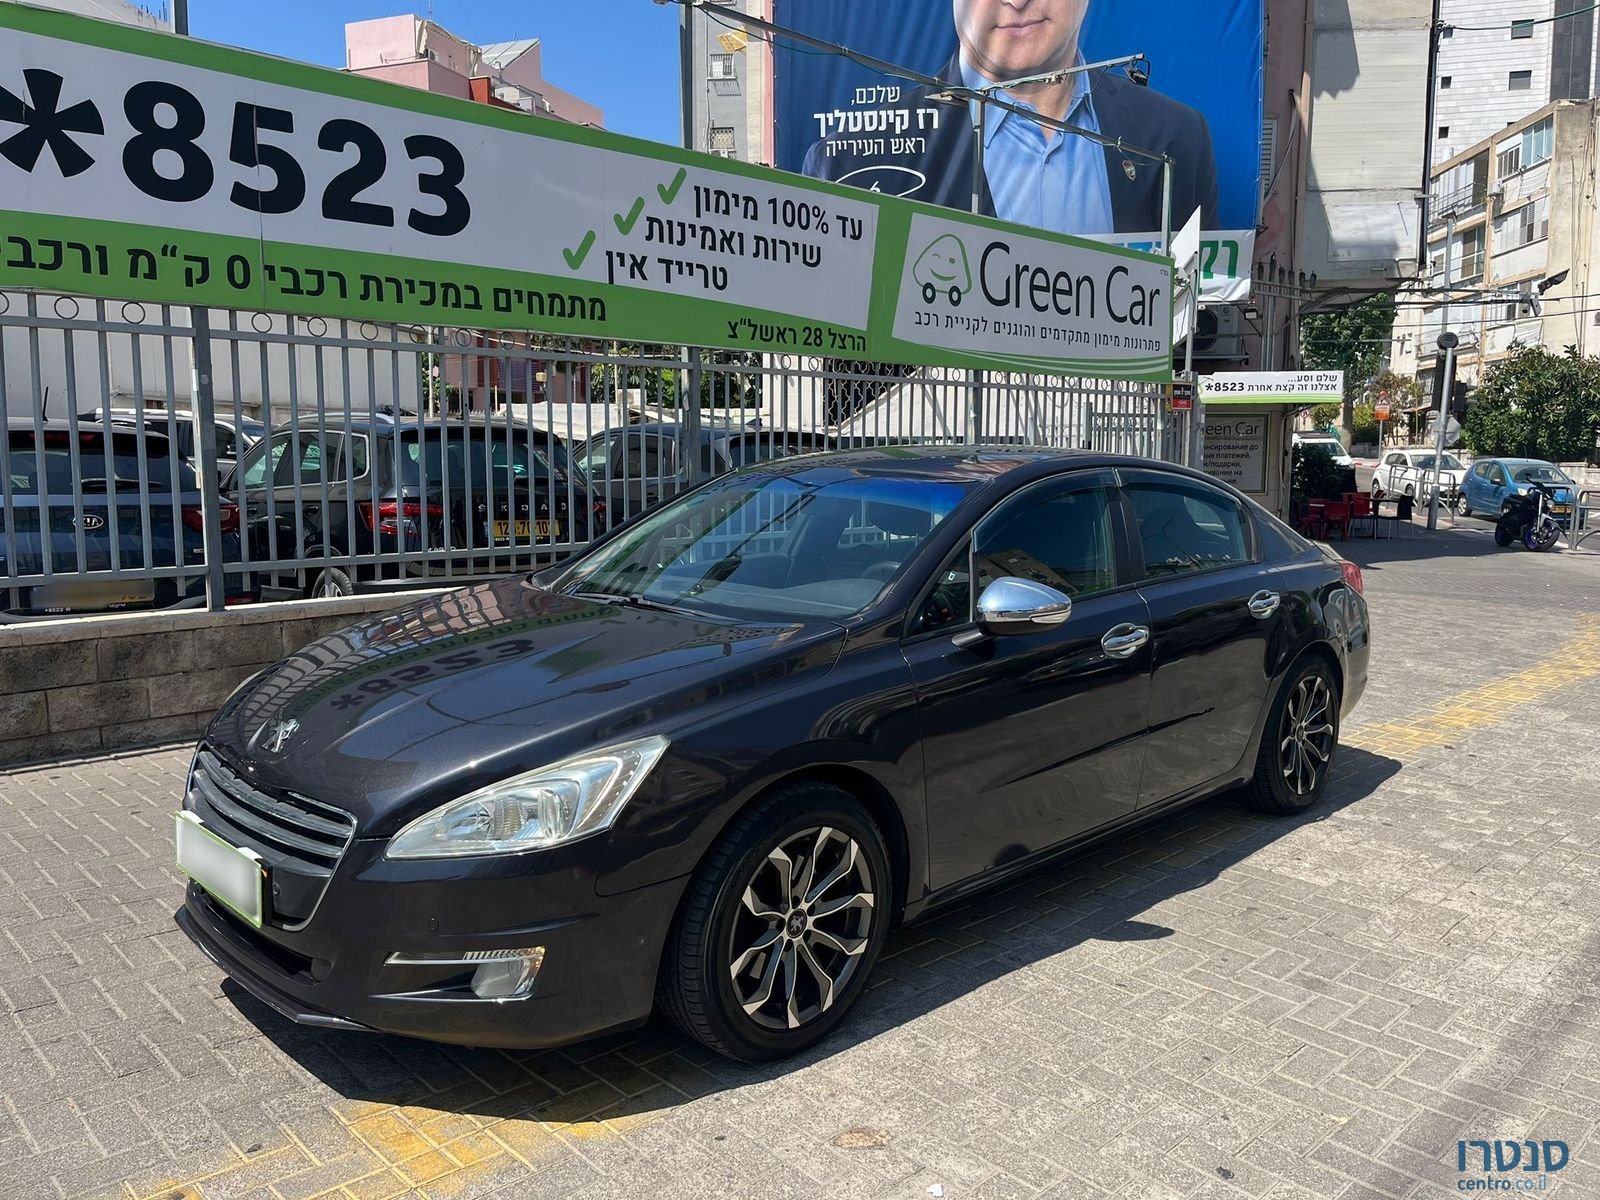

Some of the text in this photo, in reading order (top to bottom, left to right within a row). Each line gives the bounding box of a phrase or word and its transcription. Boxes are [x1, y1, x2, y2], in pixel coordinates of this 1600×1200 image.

[850, 85, 900, 106] שלכם,
[813, 108, 939, 138] רז קינסטליך
[826, 137, 926, 157] ראש העירייה
[693, 185, 863, 240] עד 100% מימון
[0, 235, 109, 276] ורכב
[645, 216, 821, 268] שירות ואמינות
[226, 255, 251, 290] 0
[263, 264, 347, 299] רכבי
[605, 250, 728, 291] טרייד אין
[979, 241, 1160, 327] Green Car
[359, 273, 483, 311] במכירת
[492, 286, 606, 321] מתמחים
[802, 326, 823, 347] 28
[827, 330, 867, 352] הרצל
[914, 311, 1161, 352] פתרונות מימון מתקדמים והוגנים לקניית רכב
[1275, 384, 1295, 393] קצת
[1297, 383, 1308, 391] זה
[1310, 383, 1337, 391] אצלנו
[1316, 373, 1338, 382] שלם
[1235, 421, 1260, 435] Car
